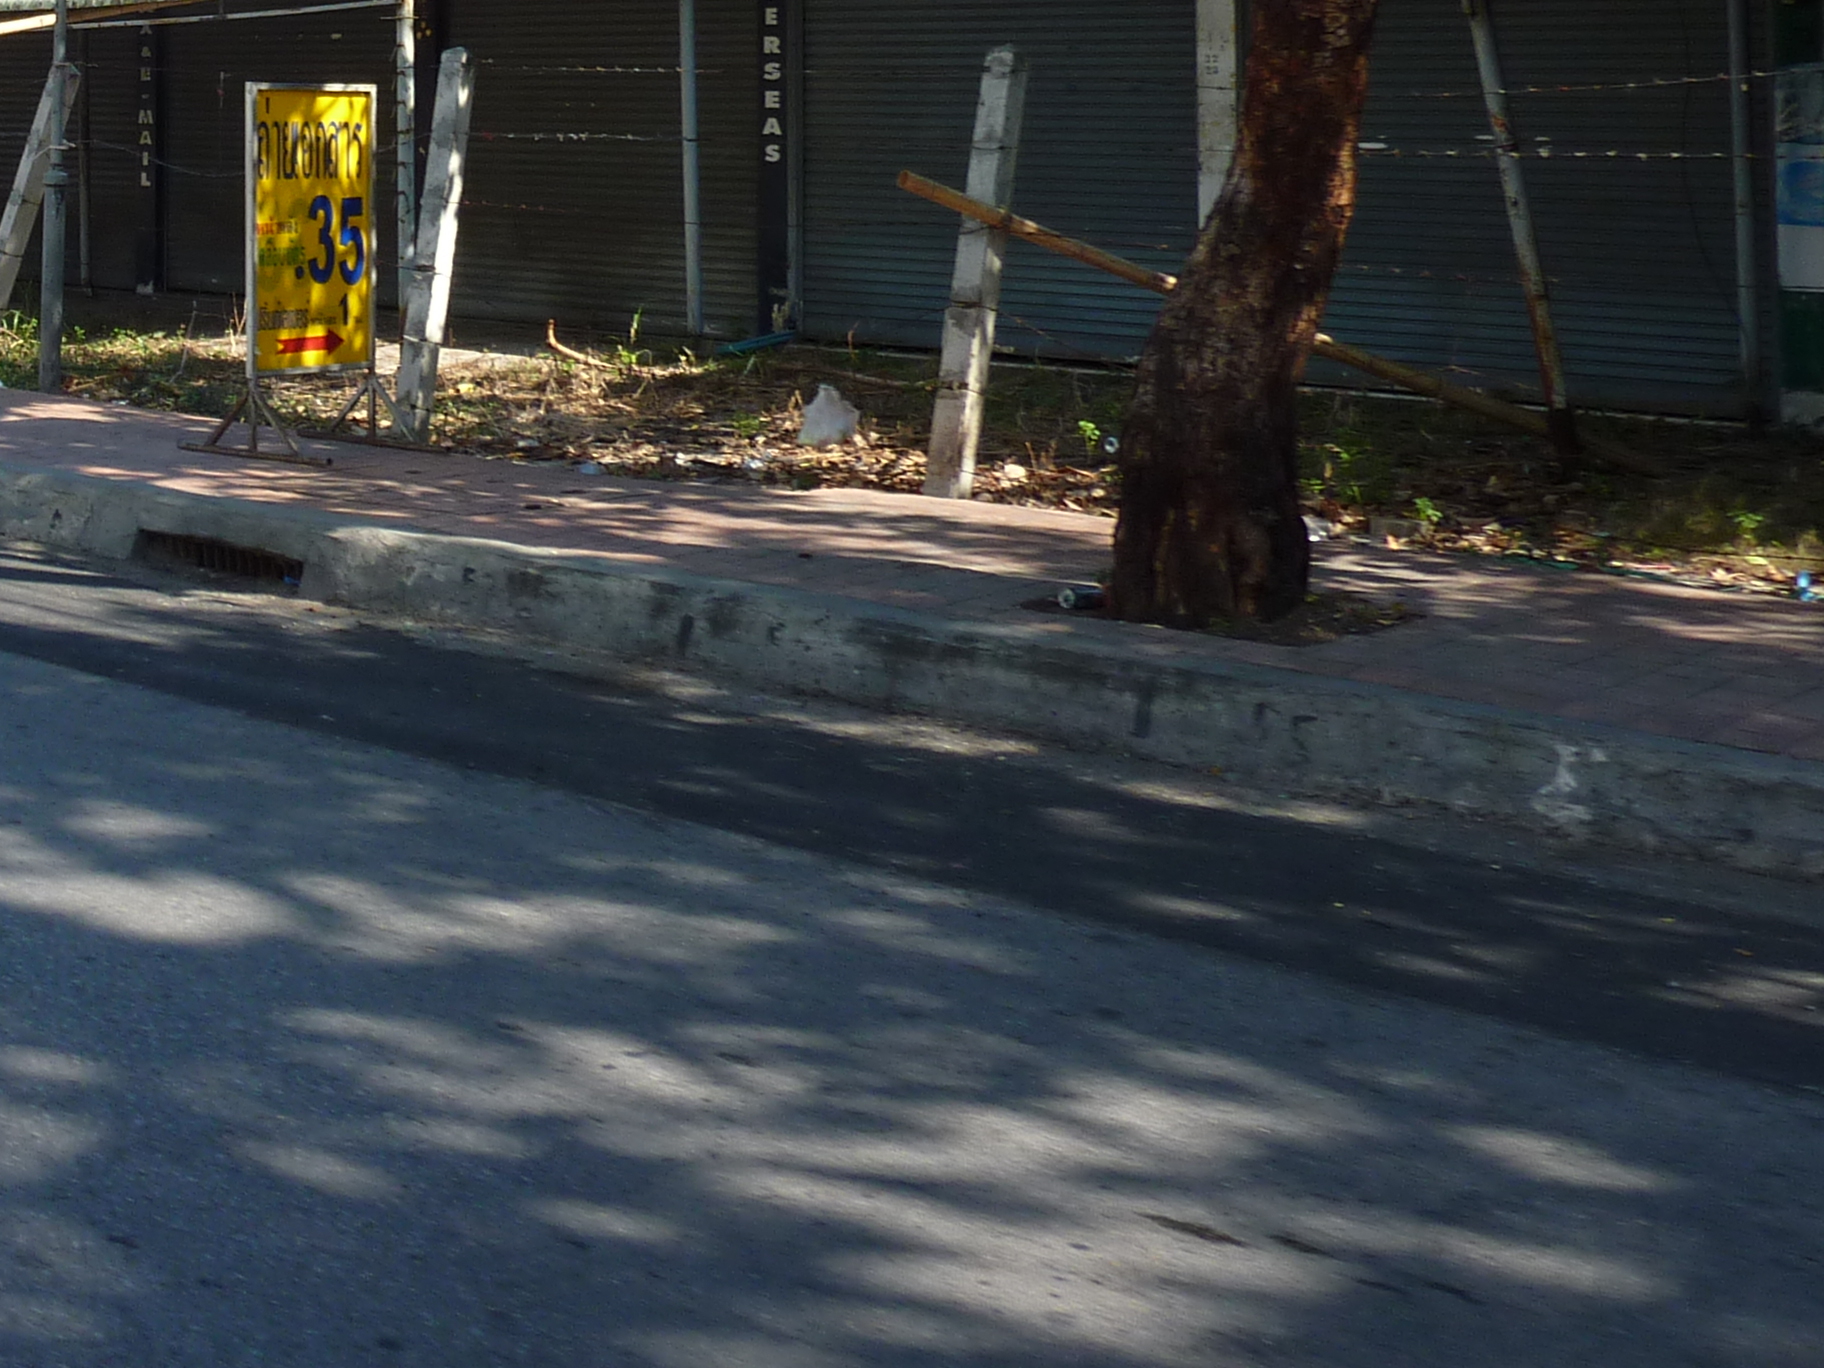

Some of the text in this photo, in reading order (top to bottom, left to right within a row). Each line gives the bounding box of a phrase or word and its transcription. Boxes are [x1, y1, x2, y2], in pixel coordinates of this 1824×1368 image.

[257, 97, 363, 180] ถ่ายเอกสาร
[338, 293, 349, 326] 1
